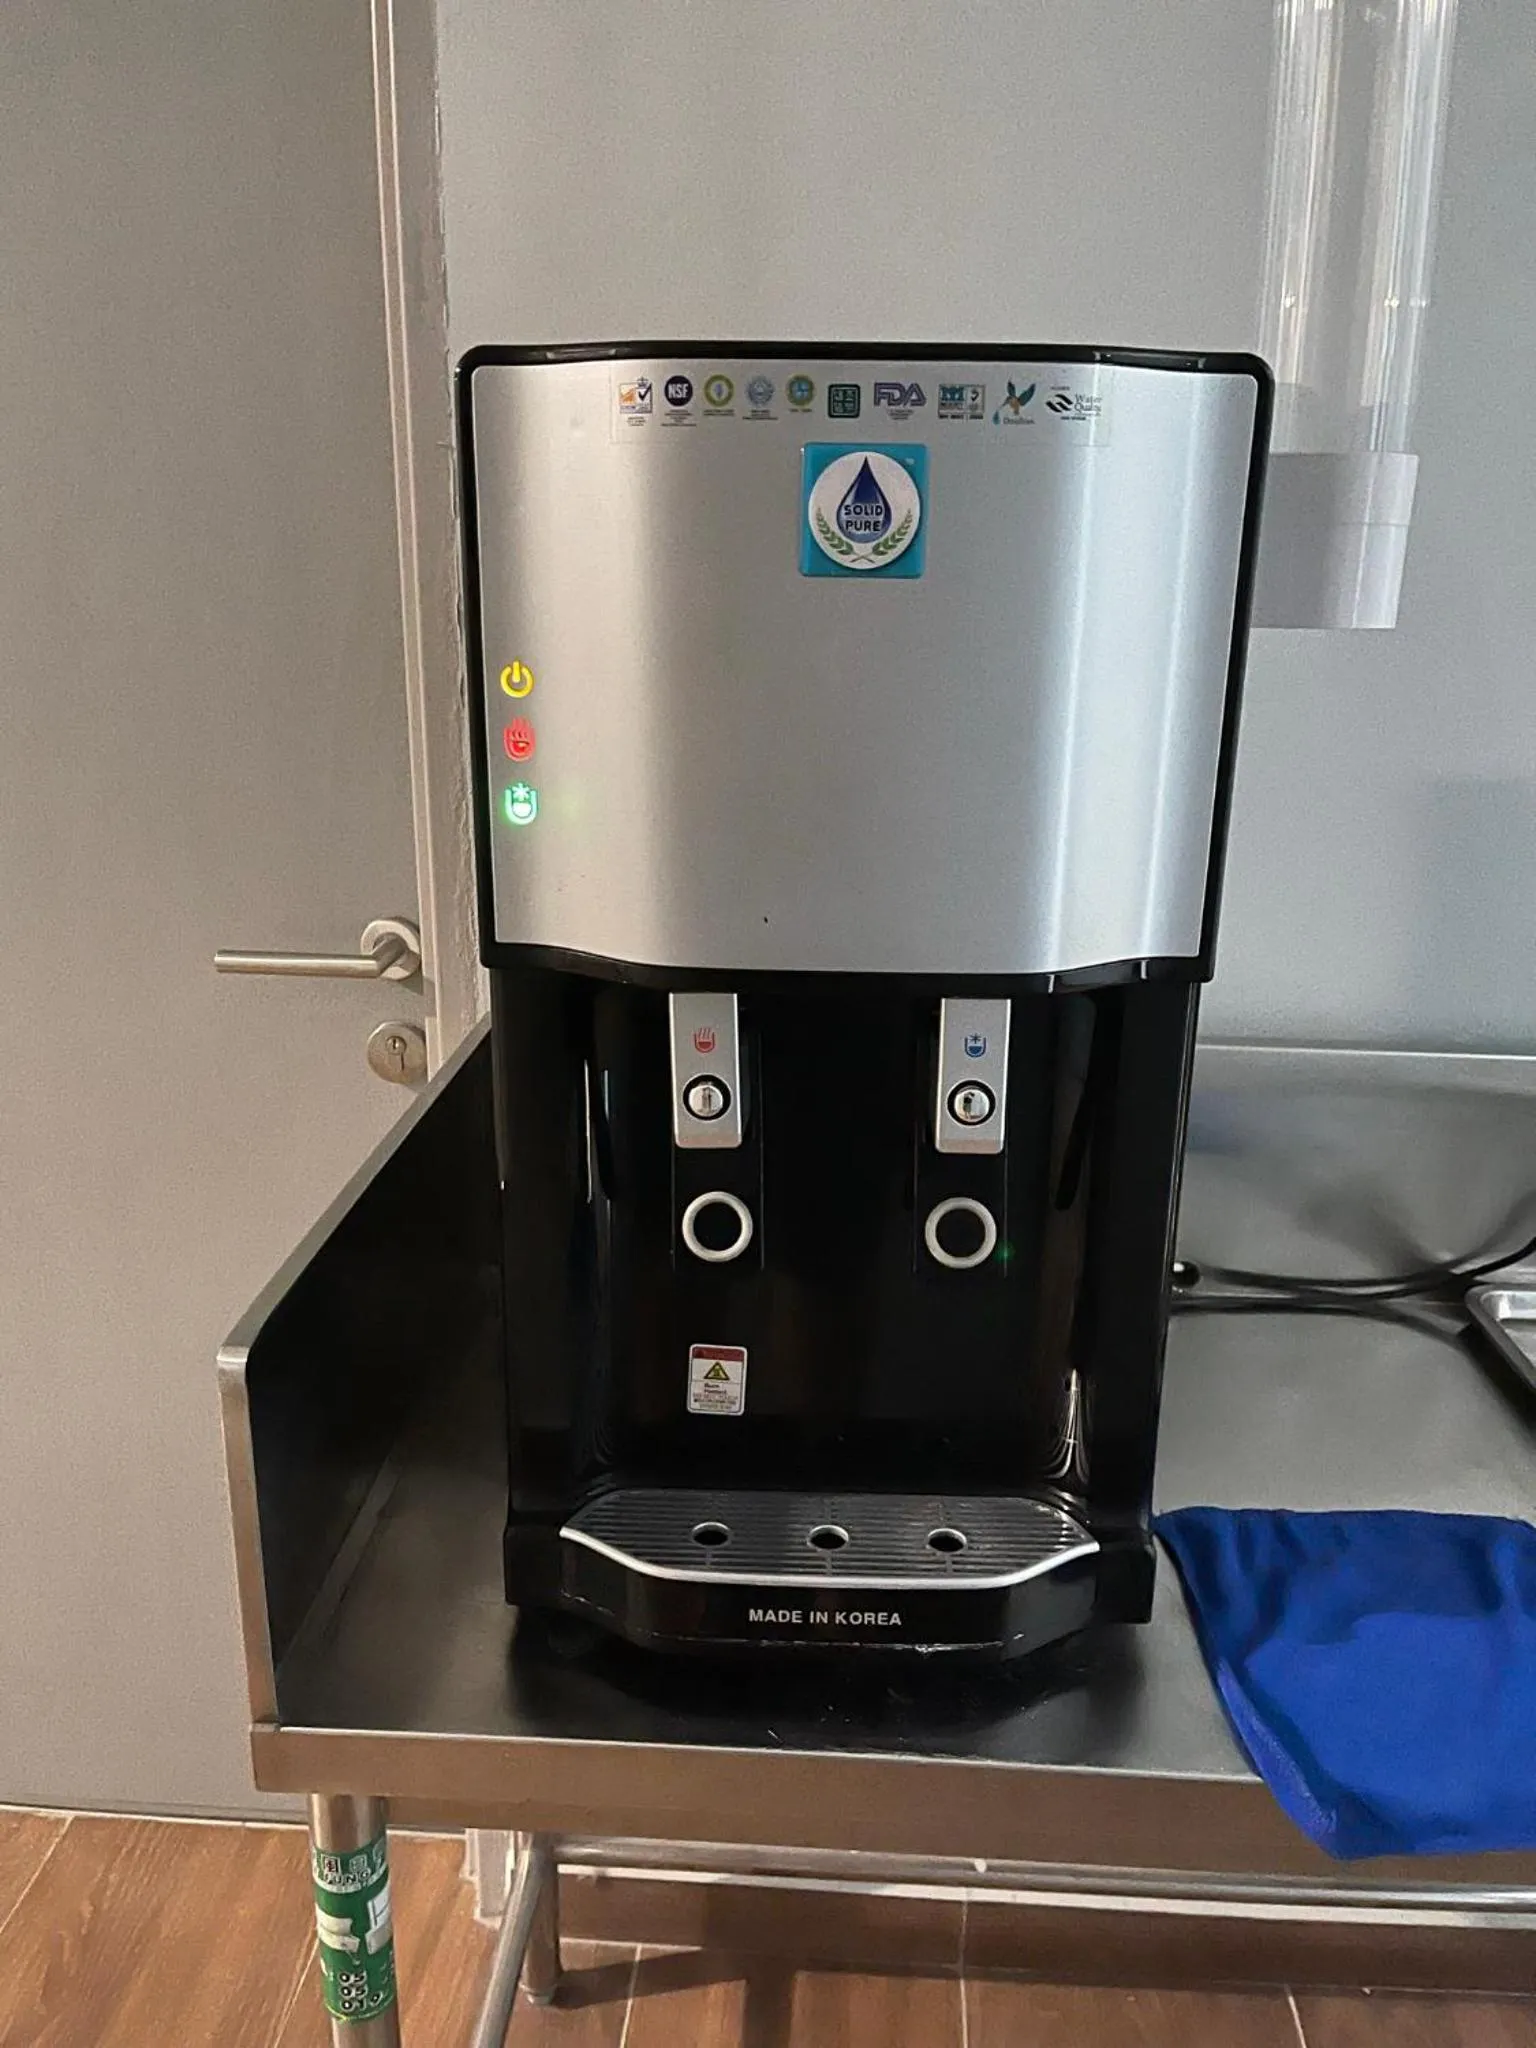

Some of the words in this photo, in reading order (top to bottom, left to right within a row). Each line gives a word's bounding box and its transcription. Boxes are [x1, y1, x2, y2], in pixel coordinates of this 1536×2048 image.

[668, 383, 690, 399] NSF
[873, 382, 927, 406] FDA
[843, 503, 883, 516] SOLID
[845, 520, 881, 532] PURE
[748, 1608, 803, 1623] MADE
[809, 1610, 829, 1624] IN
[834, 1611, 902, 1626] KOREA
